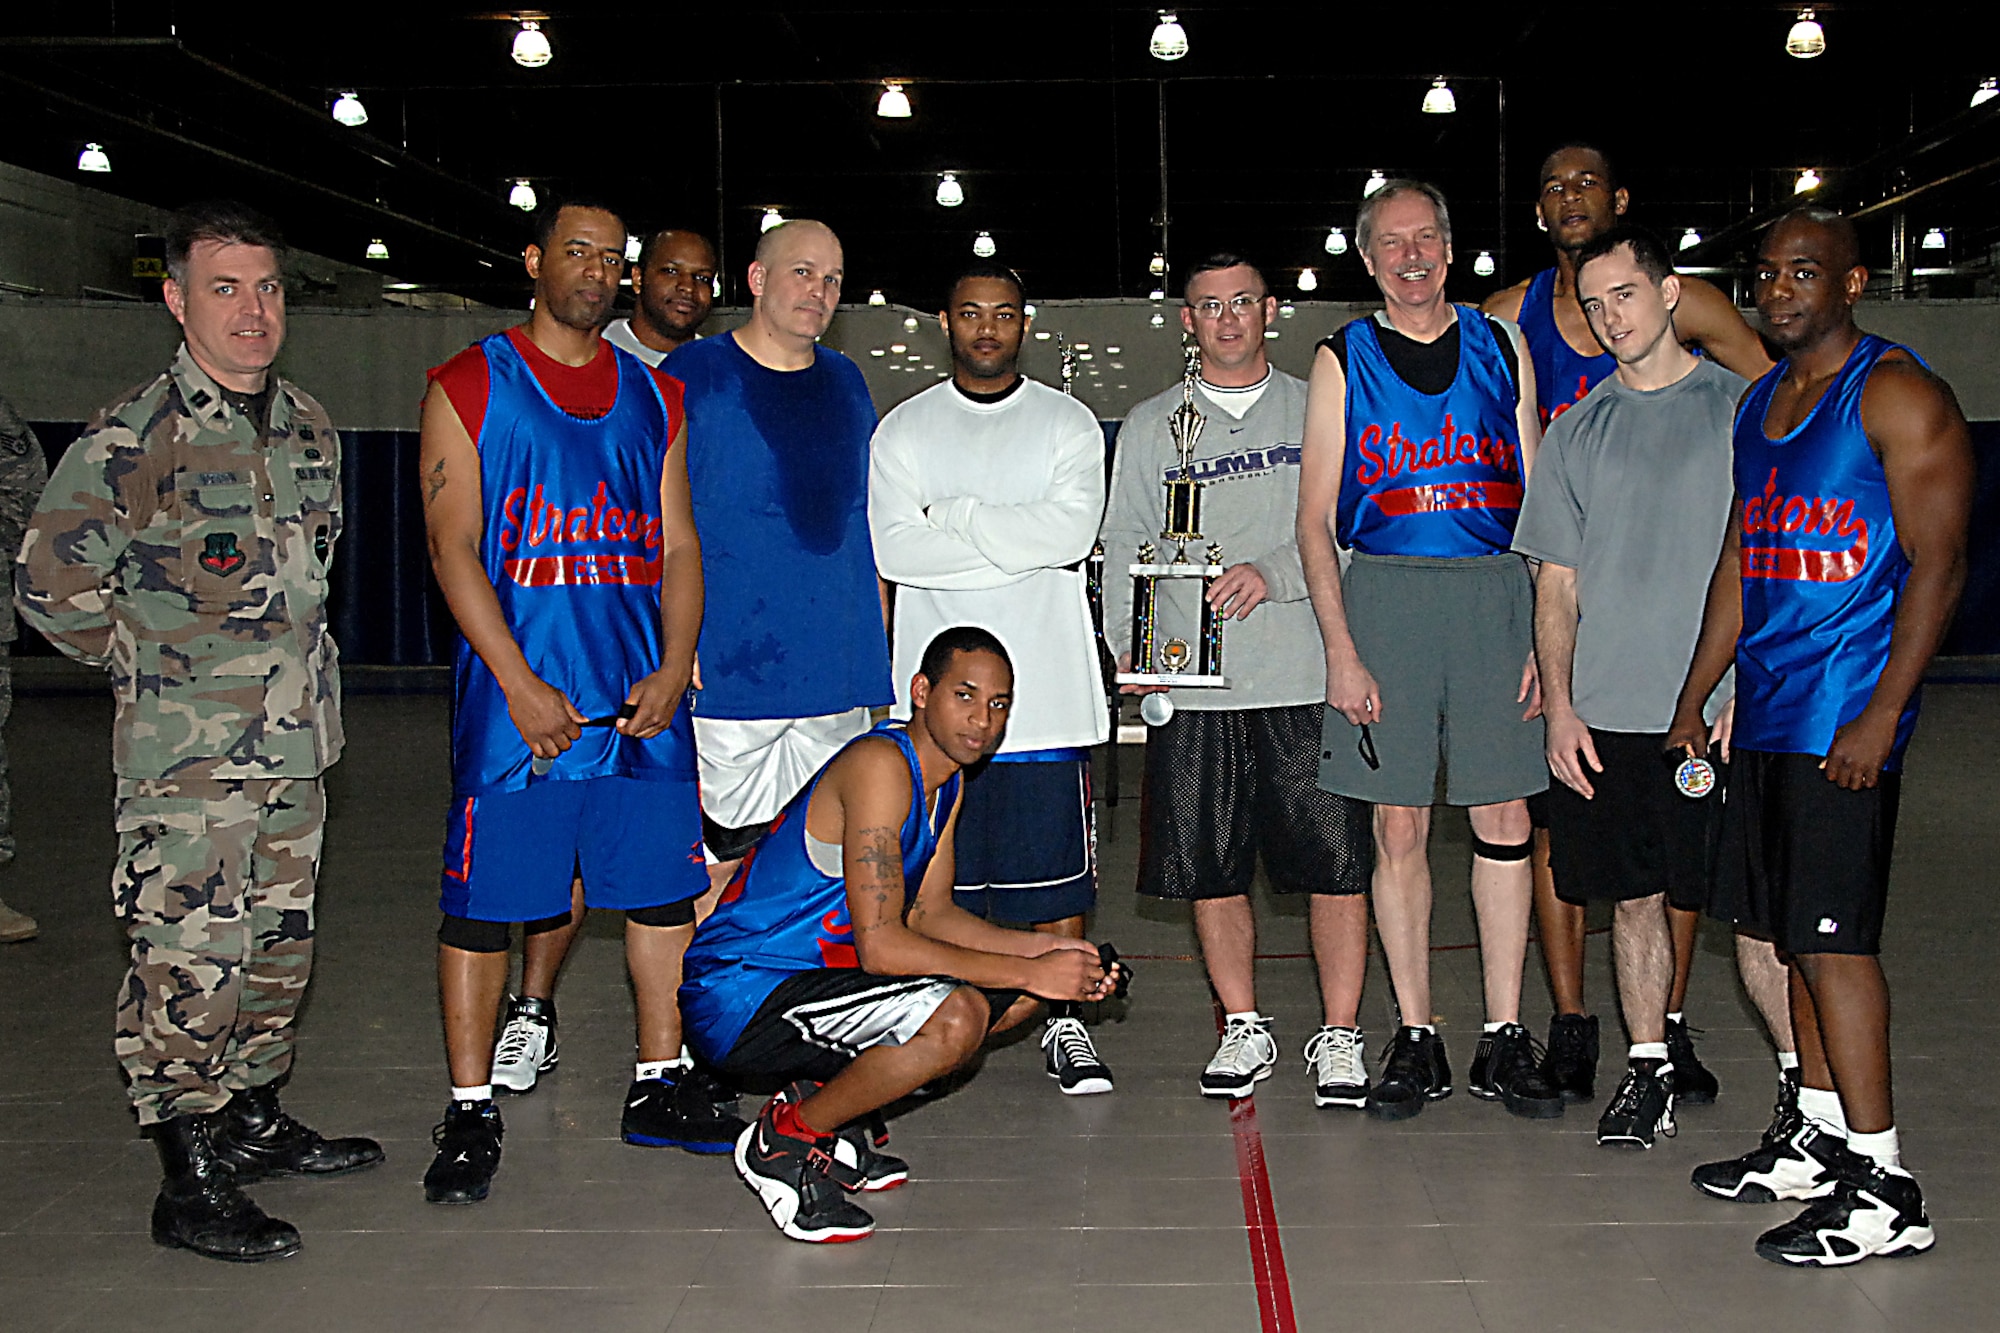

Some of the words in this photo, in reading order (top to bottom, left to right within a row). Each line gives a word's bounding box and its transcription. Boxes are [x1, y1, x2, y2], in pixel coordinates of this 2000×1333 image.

[1164, 451, 1265, 481] LLEVUE
[1209, 469, 1277, 486] BASEBAL
[1739, 467, 1868, 537] atcom
